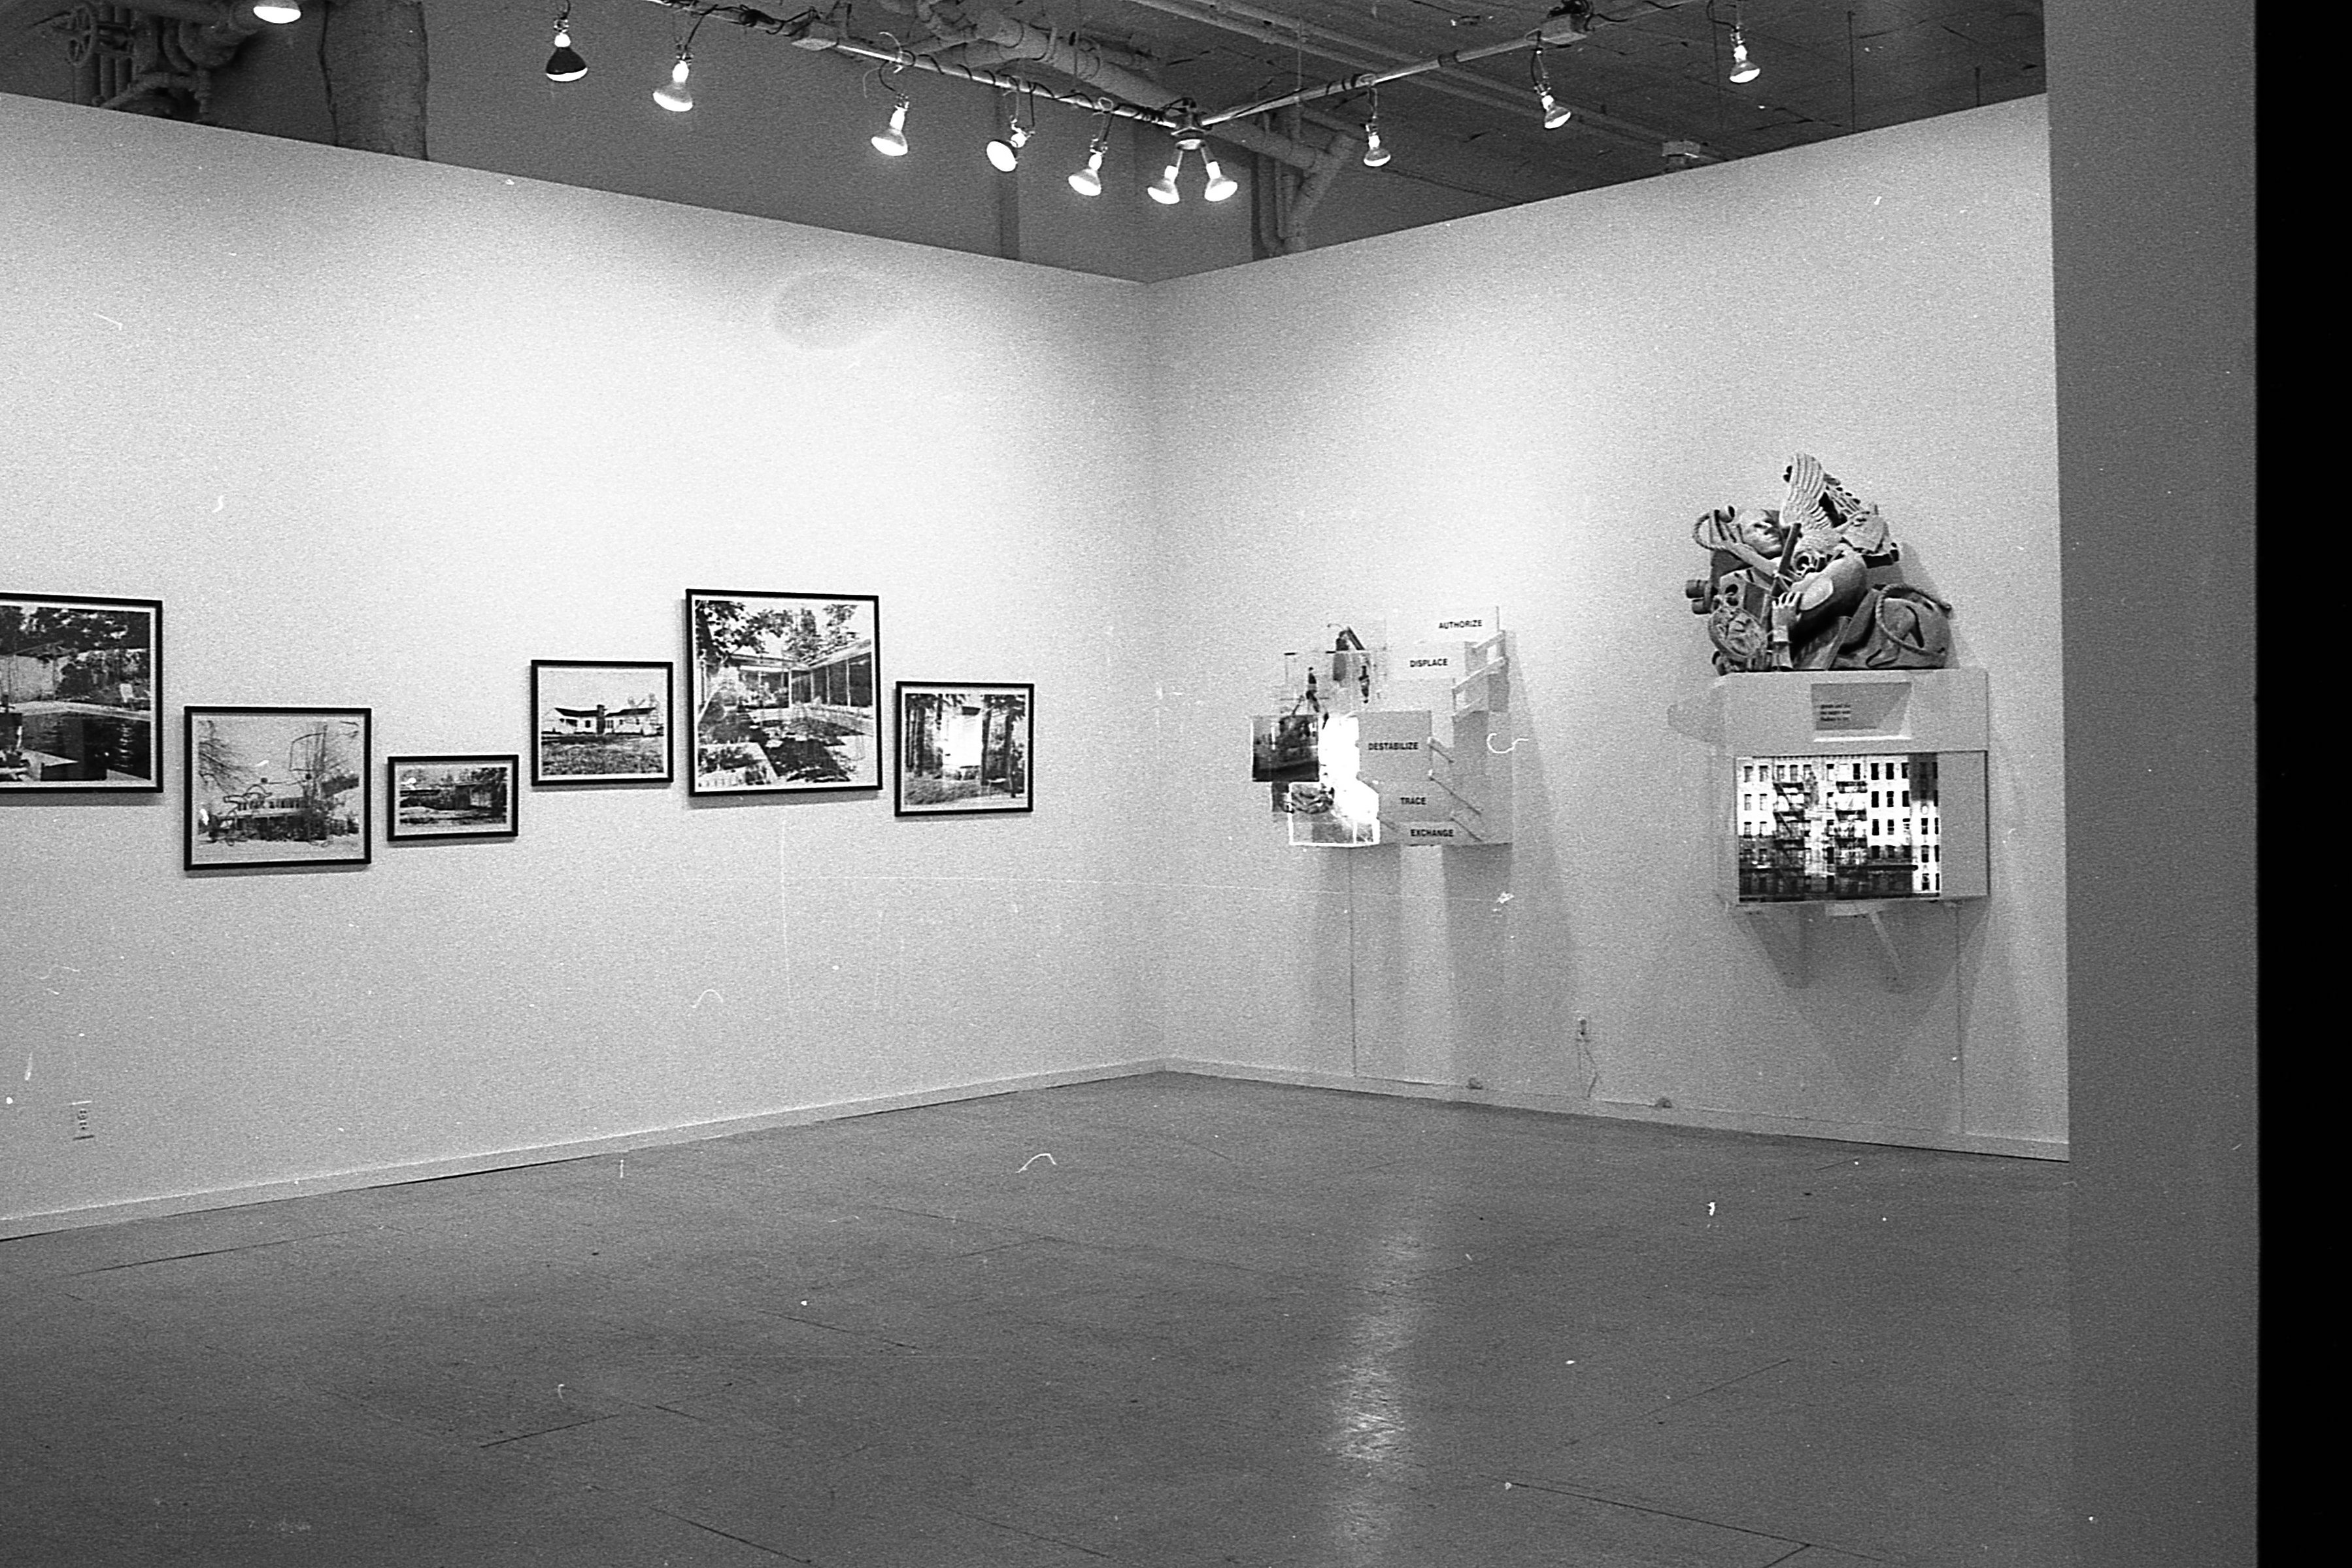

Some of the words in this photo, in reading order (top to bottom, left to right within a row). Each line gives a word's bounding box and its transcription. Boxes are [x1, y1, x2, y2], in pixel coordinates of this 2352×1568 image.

[1438, 619, 1483, 629] AUTHORIZE
[1409, 658, 1448, 667] DISPLACE
[1368, 742, 1419, 750] DESTABILIZE
[1410, 829, 1454, 837] EXCHANGE
